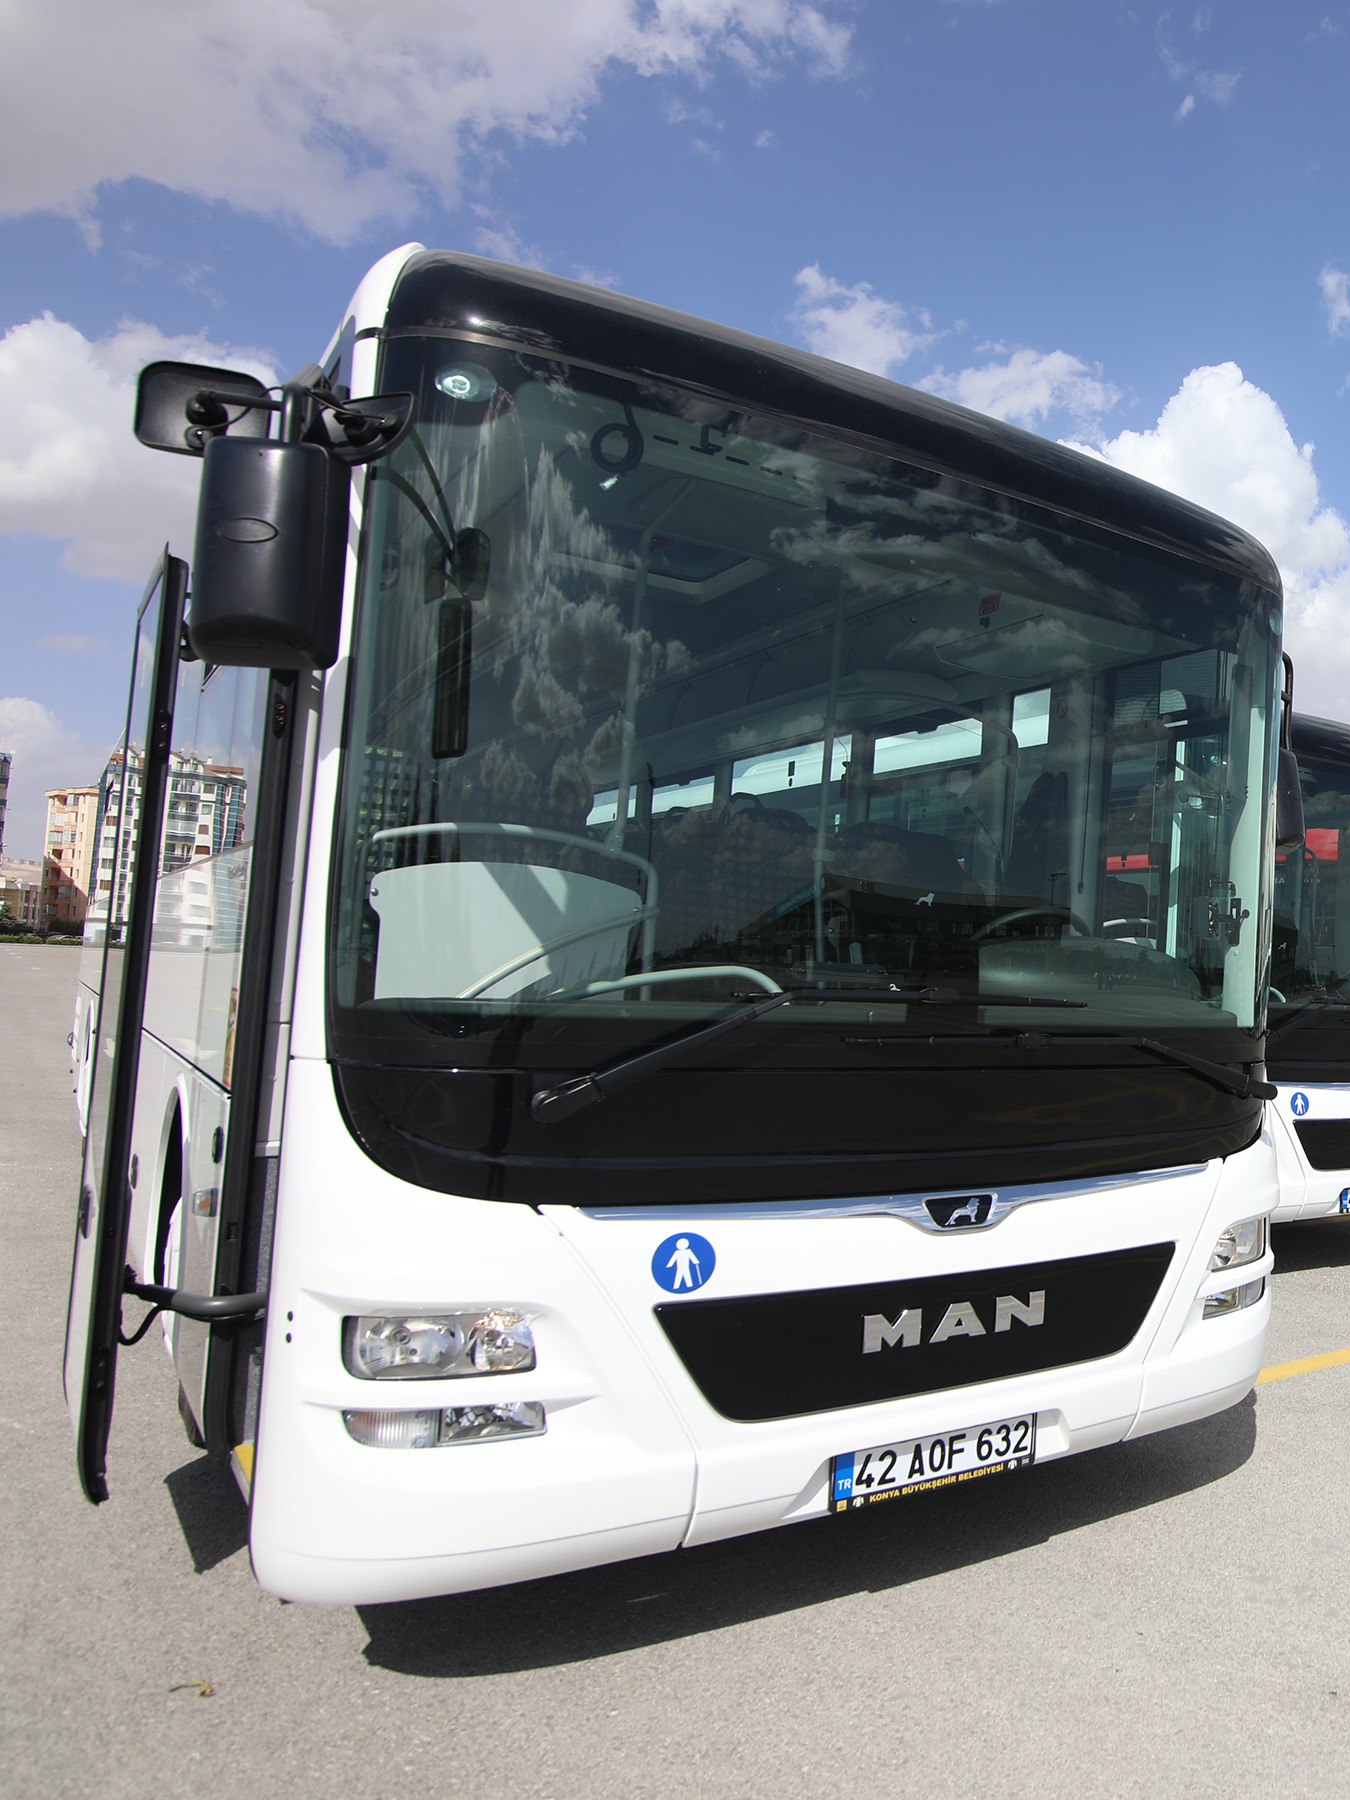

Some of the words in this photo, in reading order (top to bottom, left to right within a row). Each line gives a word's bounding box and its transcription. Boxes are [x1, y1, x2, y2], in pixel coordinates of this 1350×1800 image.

[862, 1290, 1046, 1354] MAN
[855, 1449, 897, 1488] 42
[908, 1433, 966, 1479] AOF
[976, 1420, 1030, 1461] 632
[837, 1477, 852, 1490] TR
[869, 1489, 900, 1503] KONYA
[901, 1474, 957, 1496] BÜYÜKŞEHİR
[958, 1463, 1004, 1482] BELEDİYESİ
